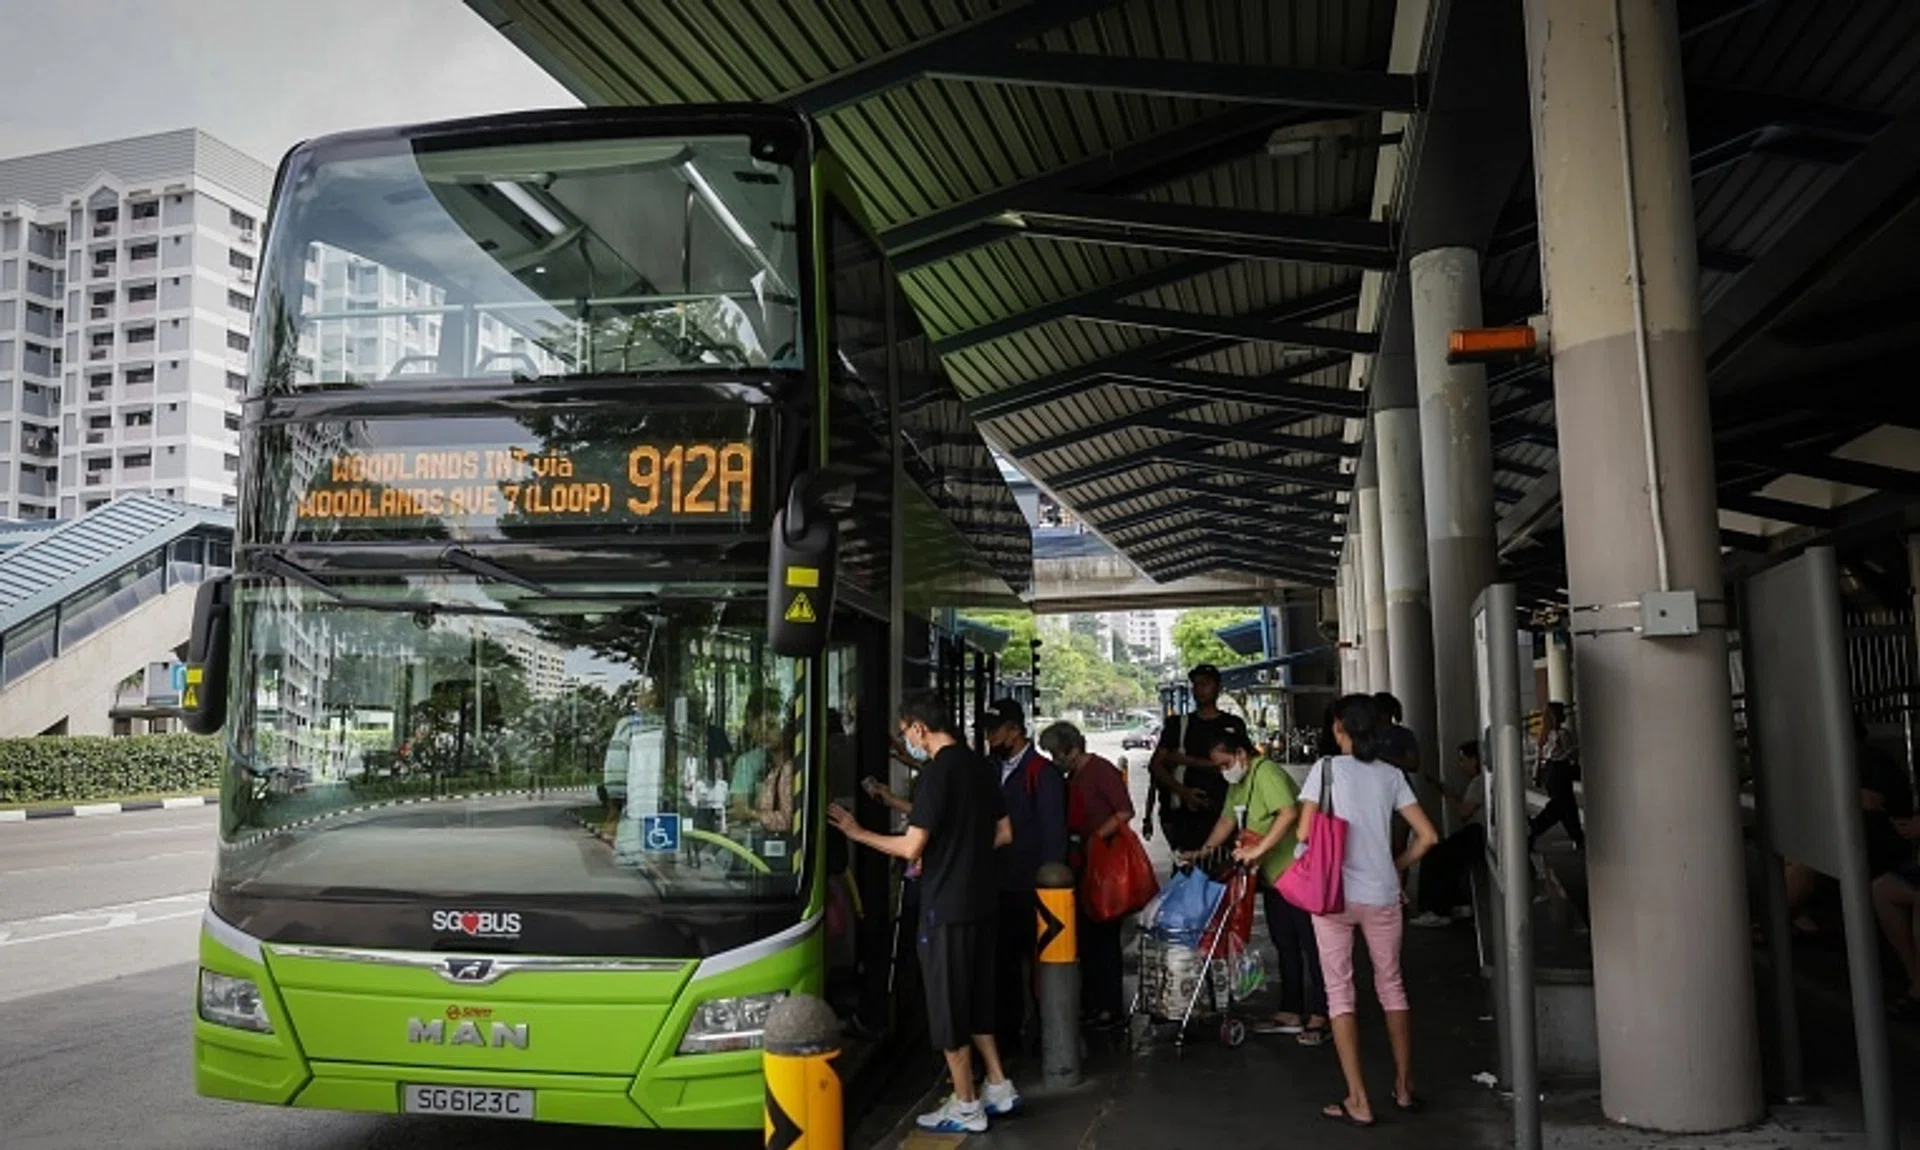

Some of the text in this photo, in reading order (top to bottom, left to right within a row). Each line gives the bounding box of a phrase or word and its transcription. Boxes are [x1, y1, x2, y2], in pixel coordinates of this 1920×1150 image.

[331, 448, 573, 483] WOODLANDS INT via
[627, 442, 751, 516] 912A
[297, 483, 611, 518] WOODLANDS AVE 7 (LOOP)
[407, 1016, 529, 1049] MAN
[418, 1089, 520, 1114] SG6123C
